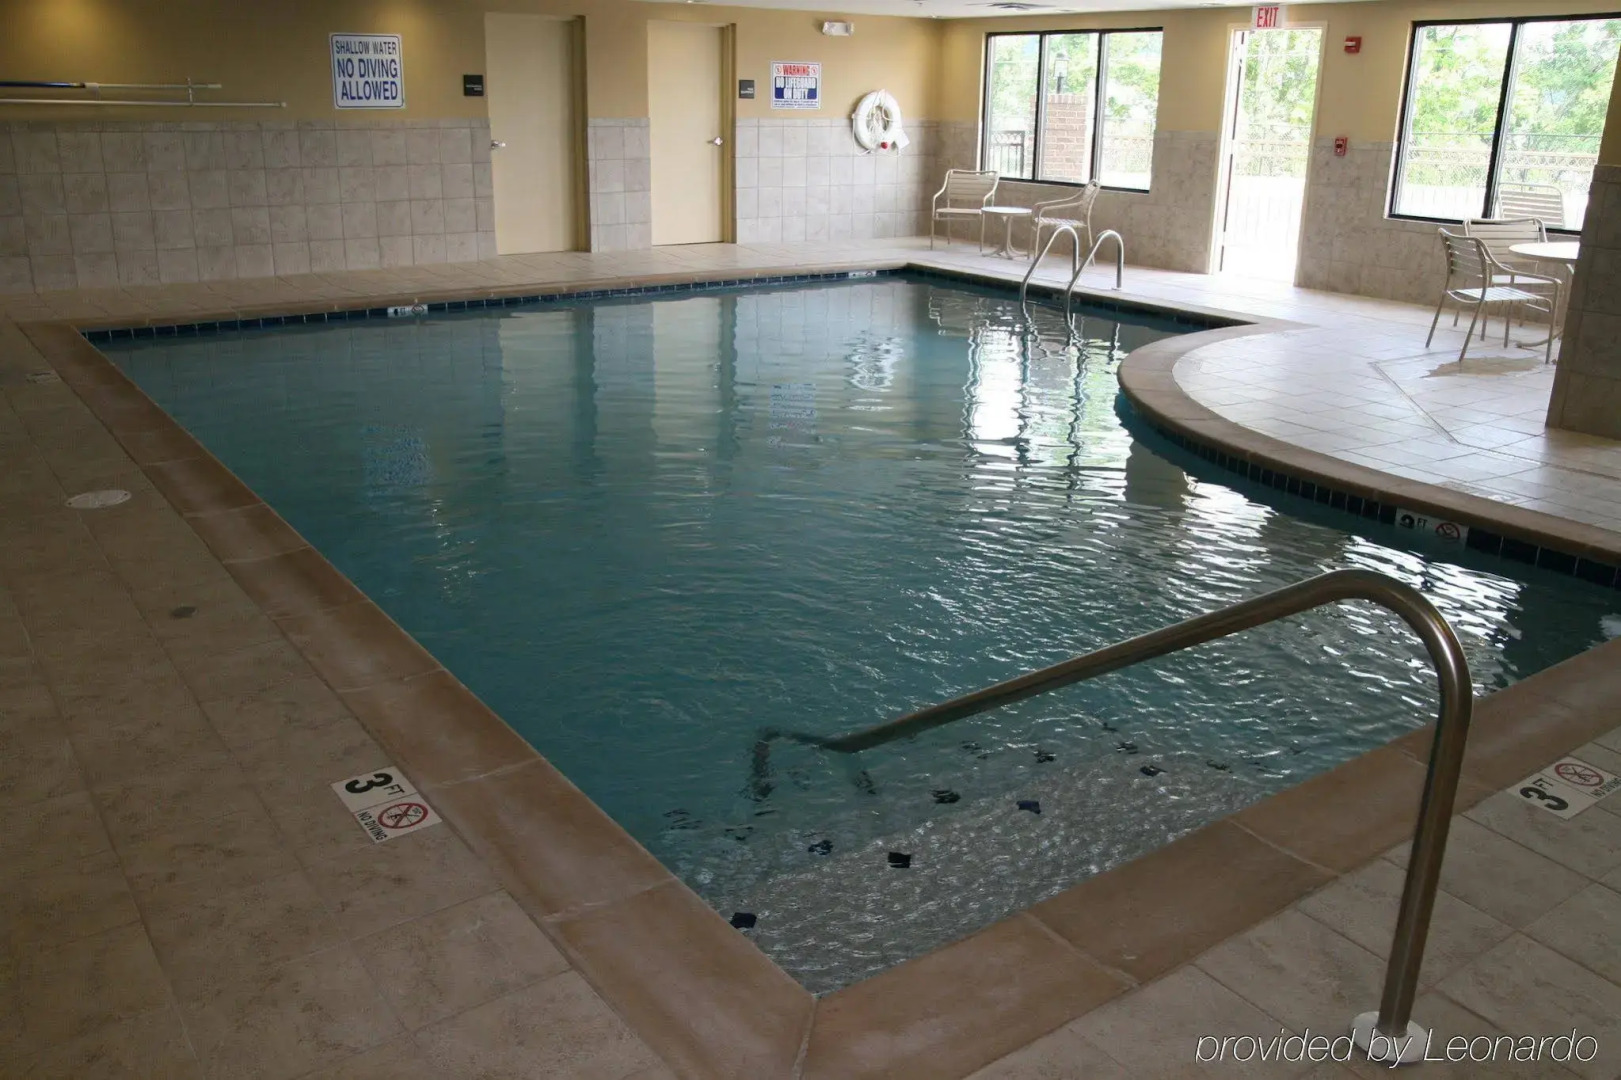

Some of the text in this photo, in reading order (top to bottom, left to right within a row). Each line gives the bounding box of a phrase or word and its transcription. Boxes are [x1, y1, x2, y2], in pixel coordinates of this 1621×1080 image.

[1256, 7, 1279, 28] EXIT
[335, 40, 397, 55] SHALLOW WATER
[337, 57, 399, 79] NO DIVING
[783, 64, 810, 76] WARNING
[341, 80, 398, 101] ALLOWED
[775, 76, 816, 89] NO LIFEGUARD
[783, 88, 808, 99] ON DUTY
[345, 772, 405, 796] 3 FT
[1519, 777, 1569, 811] 3 FT
[358, 810, 388, 841] NO DIVING
